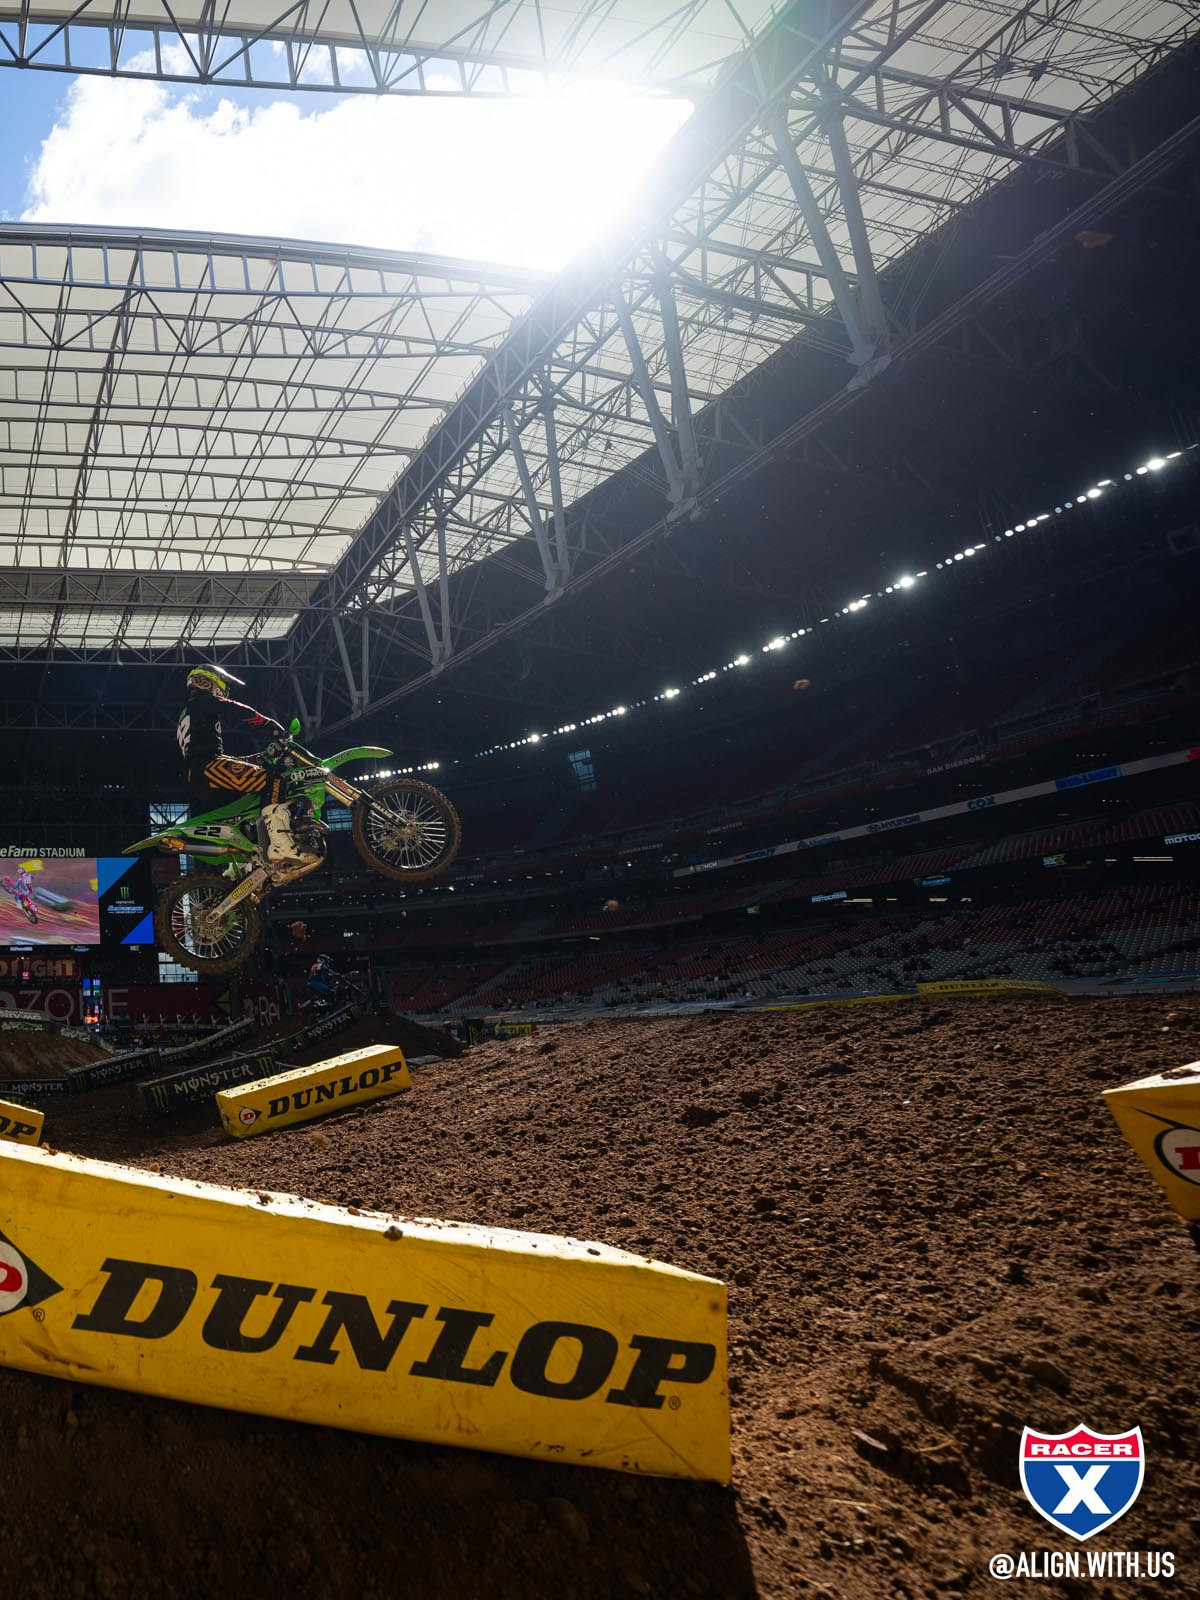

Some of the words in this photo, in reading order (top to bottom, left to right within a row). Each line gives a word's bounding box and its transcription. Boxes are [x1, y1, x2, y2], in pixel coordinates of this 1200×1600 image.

[967, 797, 995, 810] COX
[881, 815, 920, 829] HYUNDAI
[194, 826, 221, 838] 22
[39, 848, 85, 857] STADIUM
[90, 1059, 144, 1081] MONSTER
[173, 1063, 254, 1096] MONSTER
[11, 1081, 64, 1093] MONSTER
[268, 1061, 402, 1118] DUNLOP
[71, 1257, 717, 1411] DUNLOP
